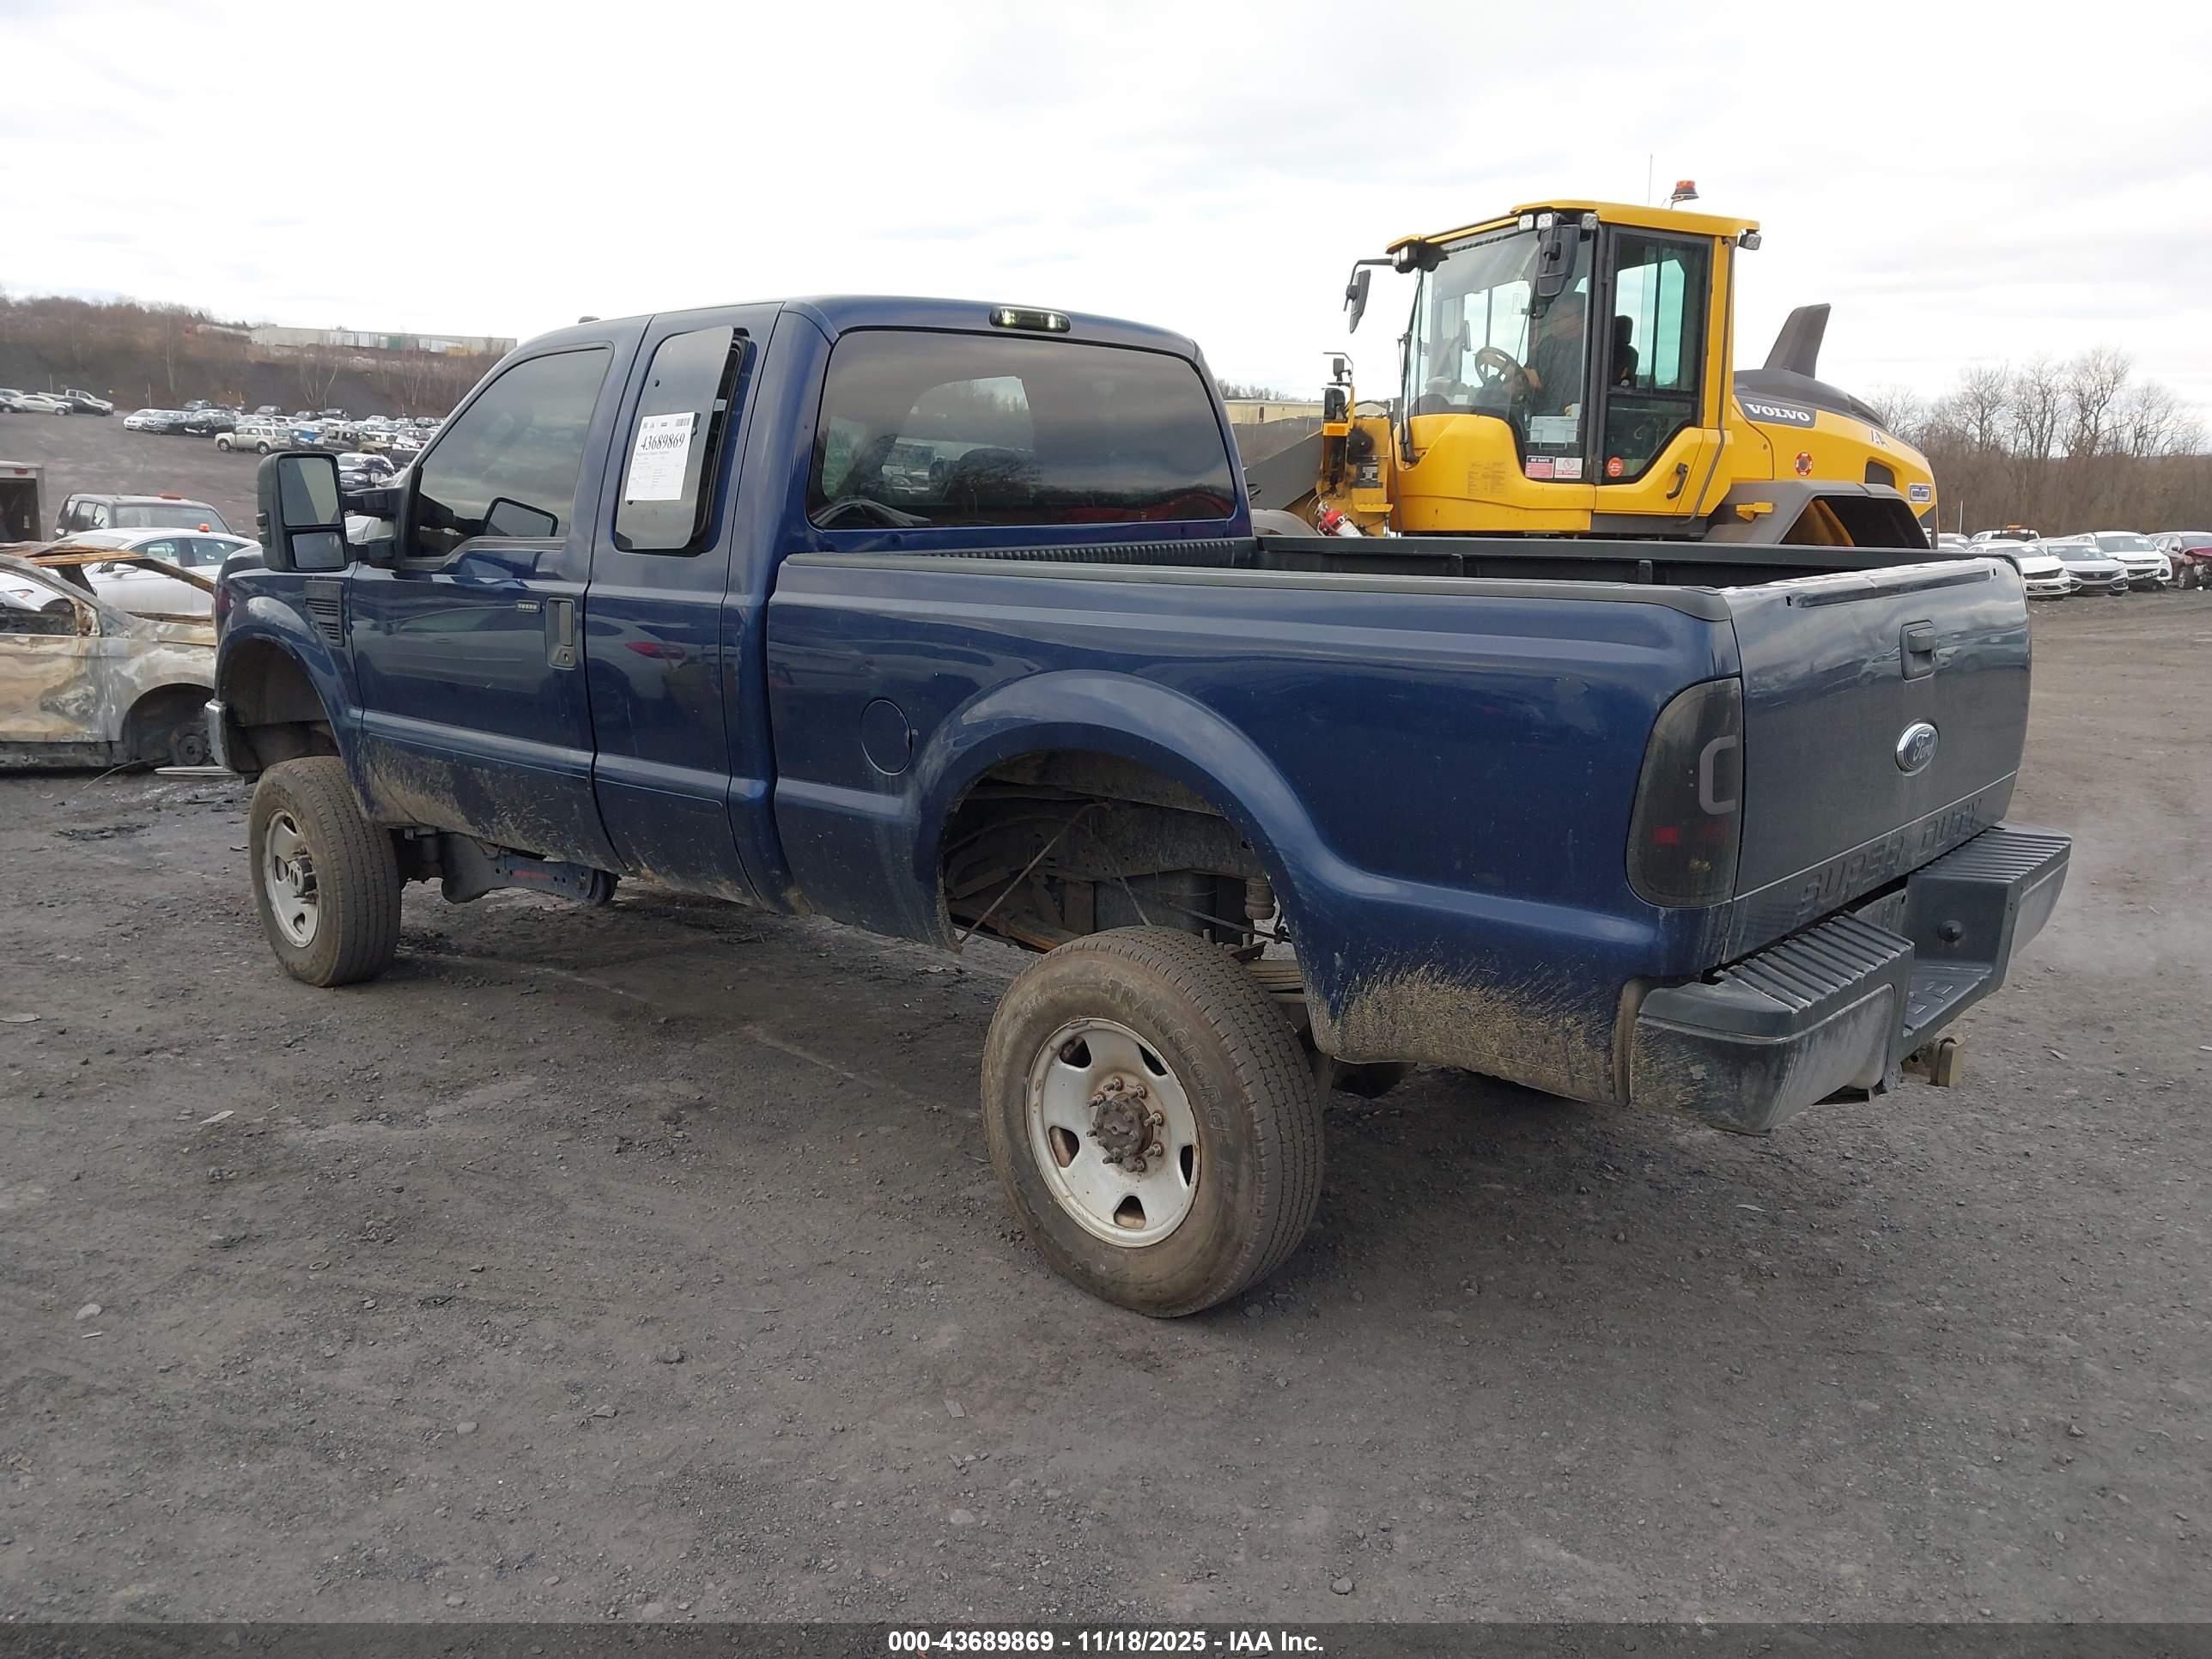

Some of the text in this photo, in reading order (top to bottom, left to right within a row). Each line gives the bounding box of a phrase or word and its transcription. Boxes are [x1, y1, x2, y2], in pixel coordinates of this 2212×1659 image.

[1745, 403, 1811, 422] VOLVO
[641, 433, 685, 451] 43689869
[1913, 732, 1936, 762] Ford
[1797, 798, 1983, 916] SUPER DUTY
